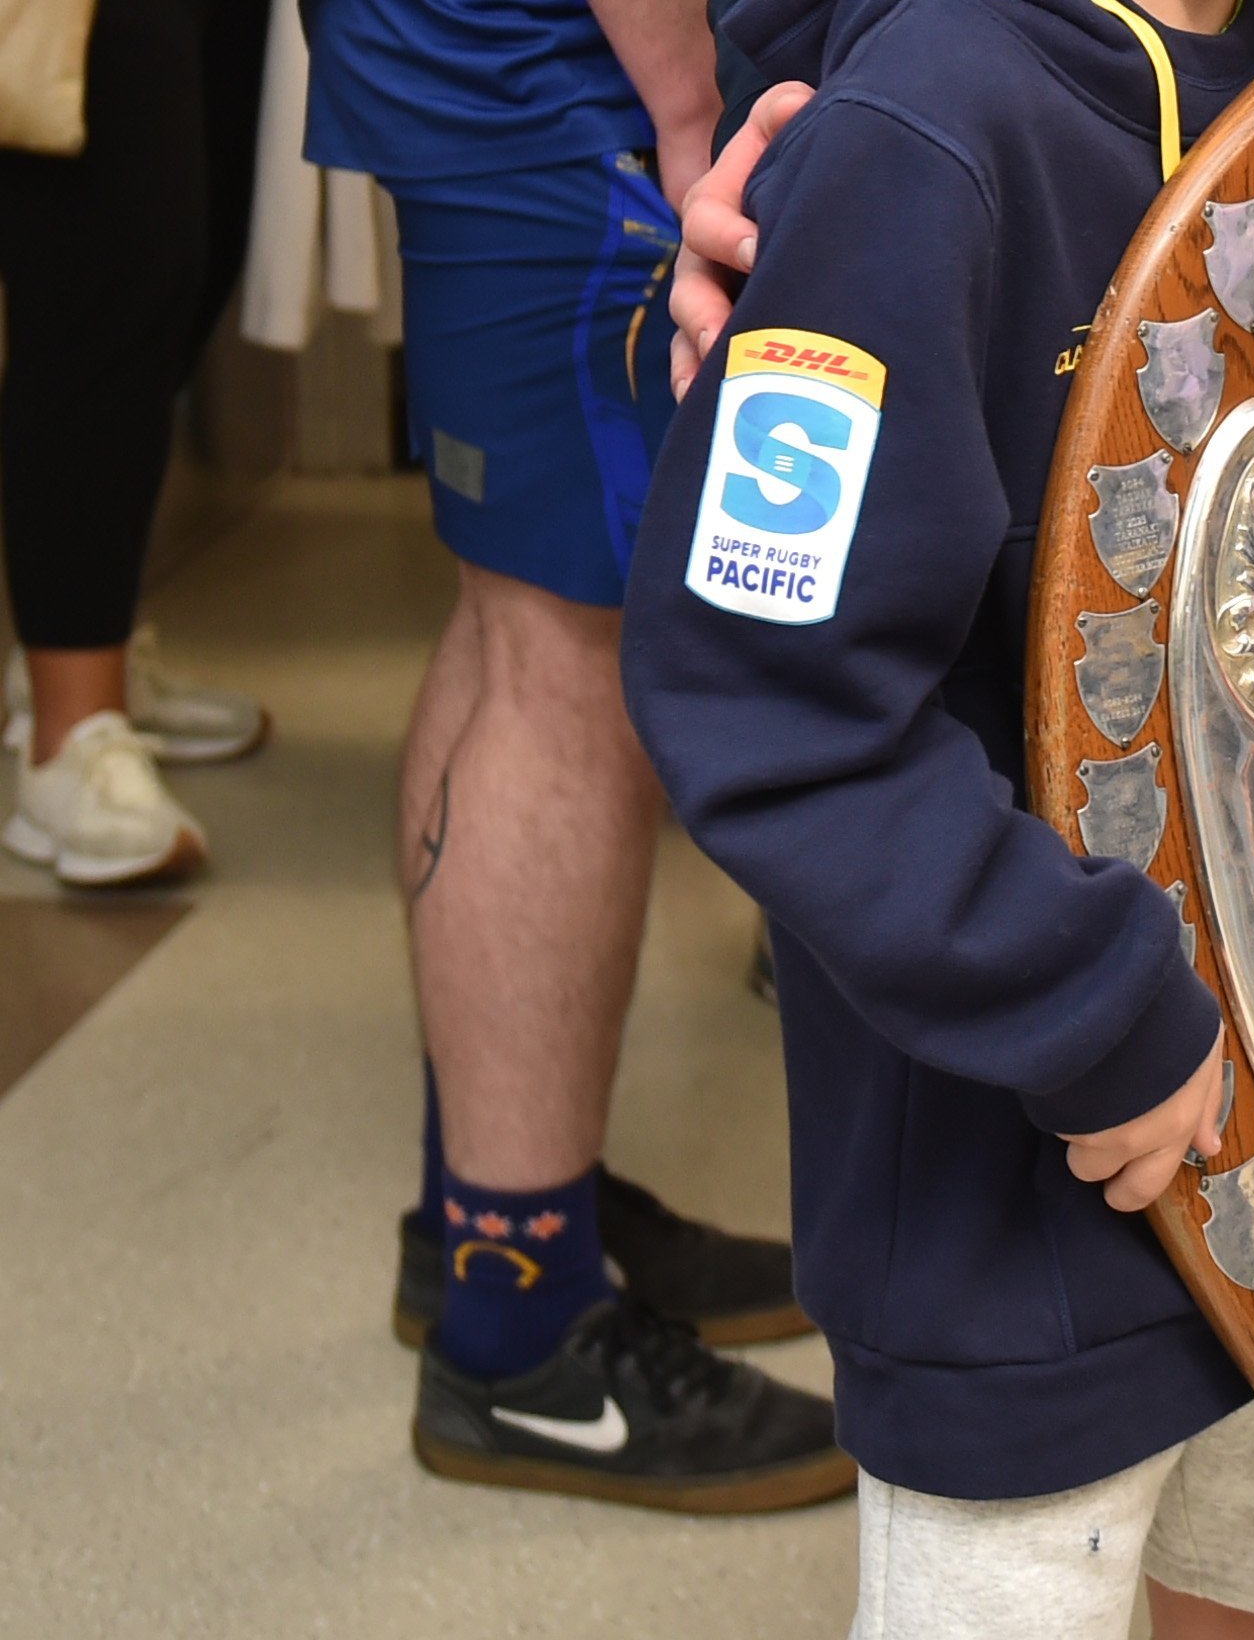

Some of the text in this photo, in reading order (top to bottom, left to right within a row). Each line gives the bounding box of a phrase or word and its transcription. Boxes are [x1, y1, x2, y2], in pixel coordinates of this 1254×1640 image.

[761, 340, 852, 376] DHL
[711, 535, 822, 571] SUPER RUGBY
[706, 555, 817, 604] PACIFIC
